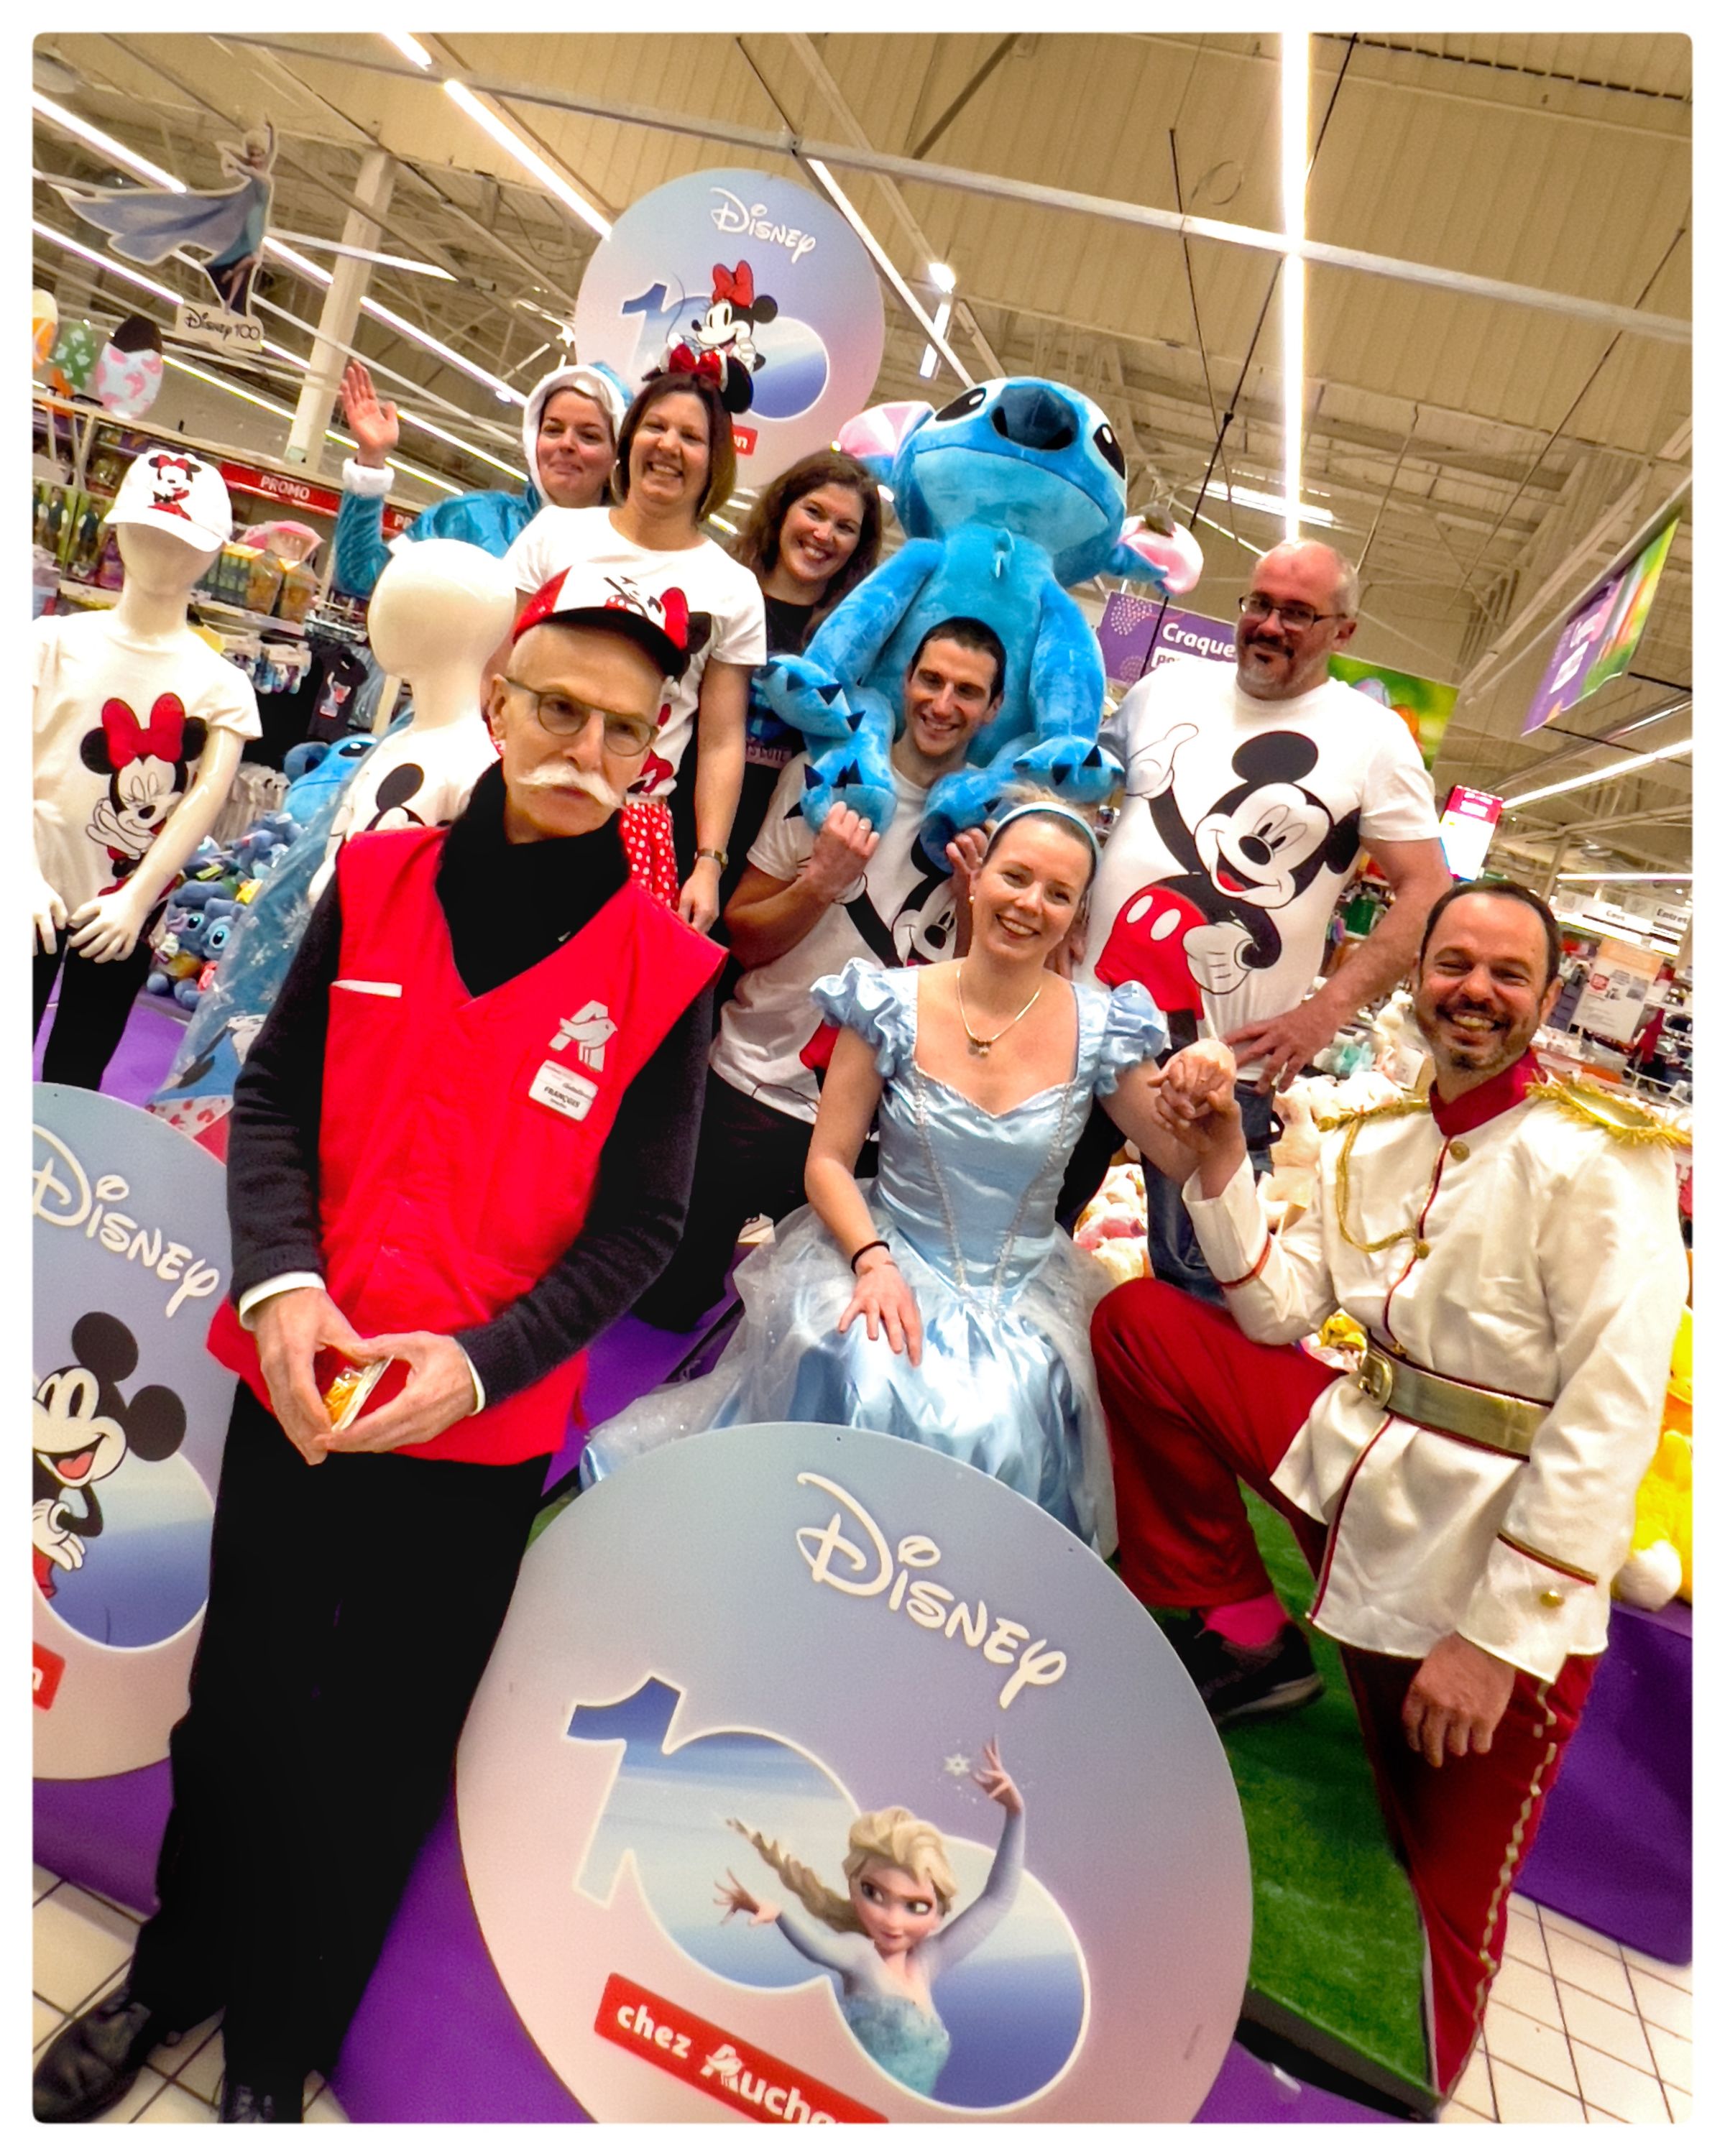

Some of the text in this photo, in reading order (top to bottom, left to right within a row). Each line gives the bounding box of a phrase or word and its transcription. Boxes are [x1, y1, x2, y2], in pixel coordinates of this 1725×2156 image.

[260, 474, 310, 500] PROMO
[616, 2004, 845, 2124] chez Auch
